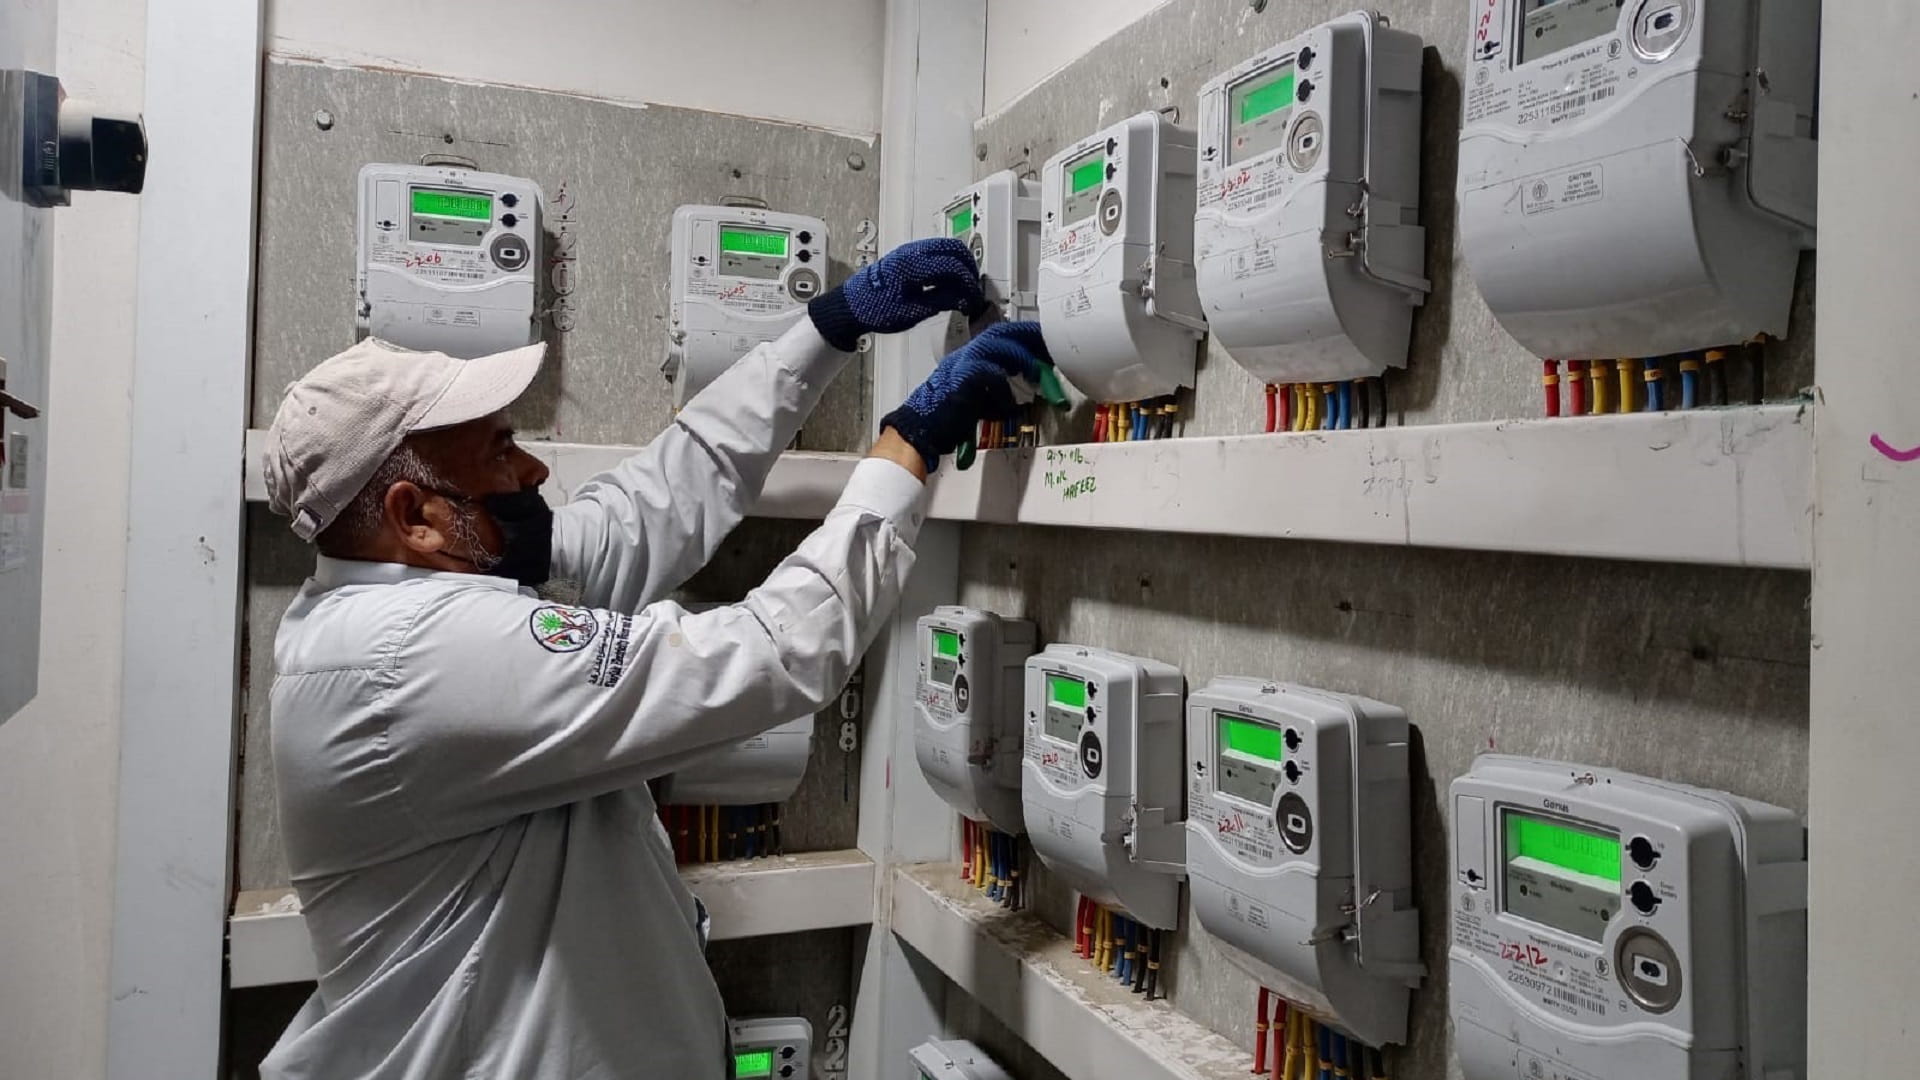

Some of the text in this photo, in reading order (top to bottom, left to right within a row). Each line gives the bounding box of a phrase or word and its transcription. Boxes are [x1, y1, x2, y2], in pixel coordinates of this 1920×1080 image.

[405, 252, 442, 268] 2206
[1543, 798, 1569, 813] Genus
[1498, 942, 1548, 968] 2212
[1507, 970, 1552, 996] 22530972
[823, 1004, 848, 1080] 22
